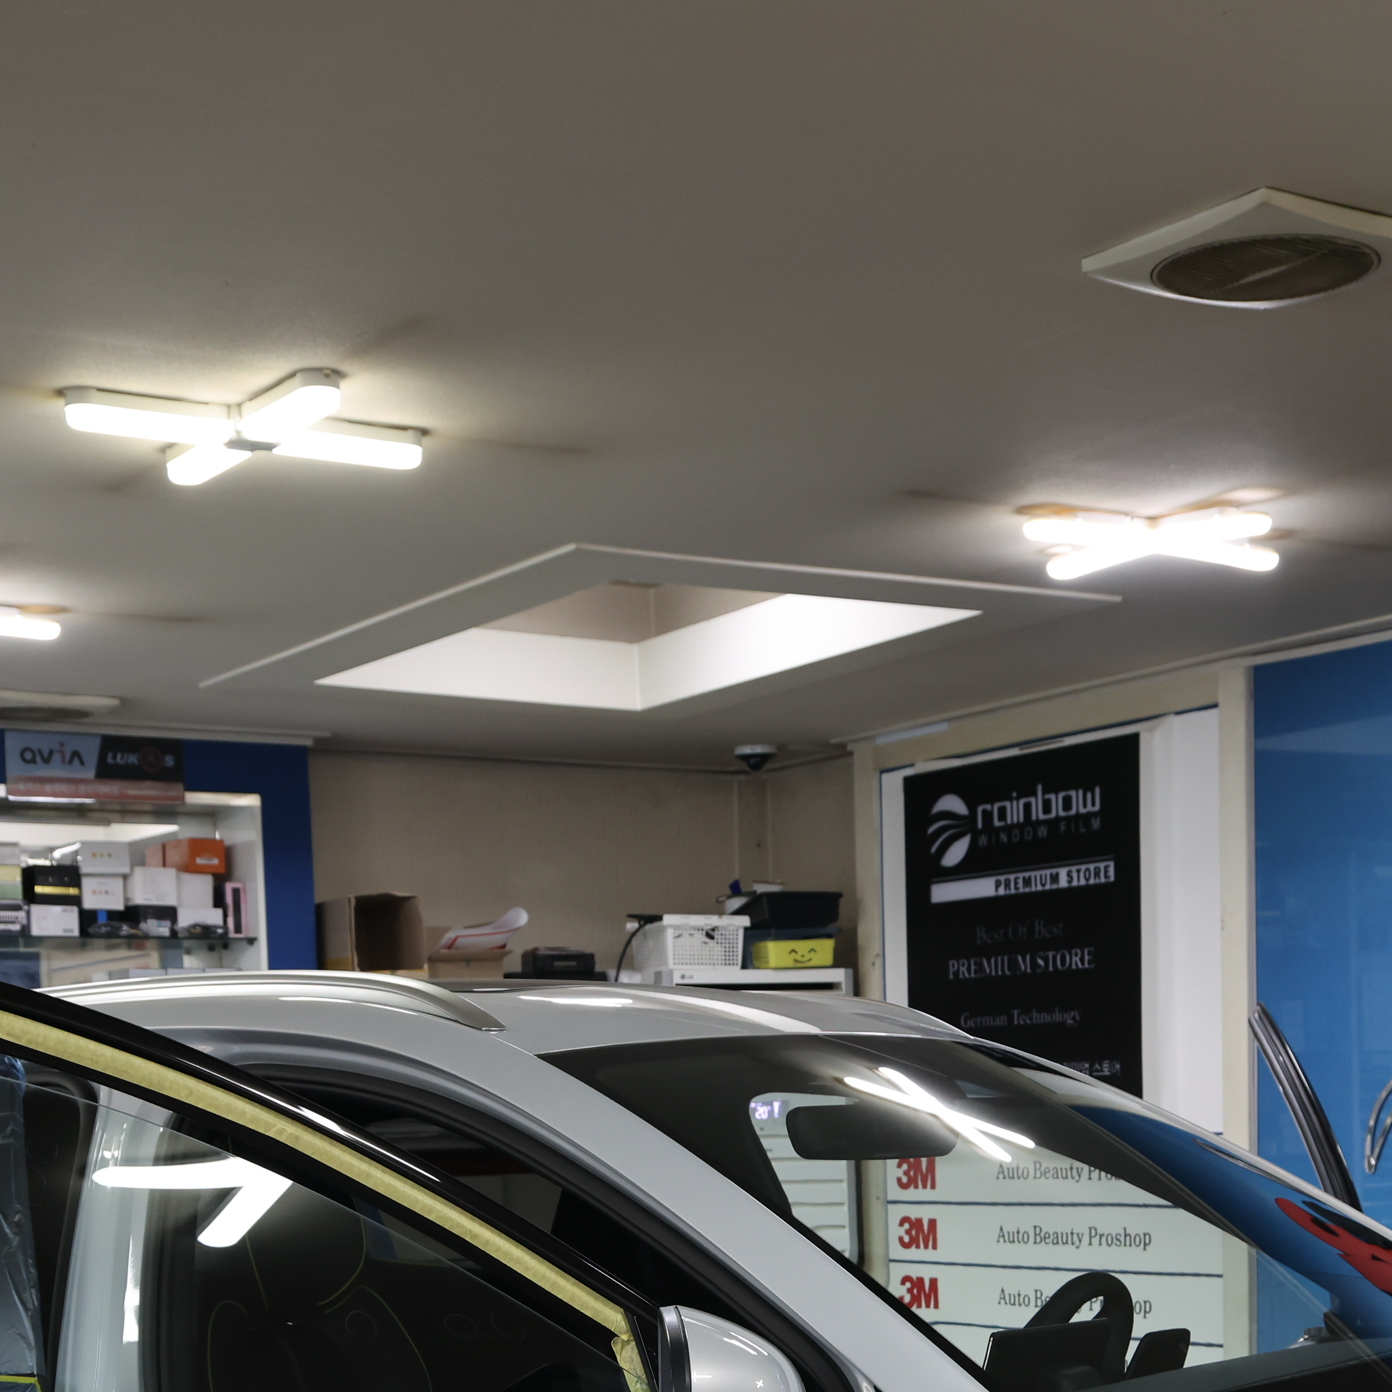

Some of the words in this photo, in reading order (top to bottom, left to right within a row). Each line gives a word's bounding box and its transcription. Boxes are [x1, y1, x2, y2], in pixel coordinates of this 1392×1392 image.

[977, 783, 1101, 829] rainbow
[977, 825, 1048, 847] WINDOW
[1060, 816, 1101, 834] FILM
[994, 871, 1060, 894] PREMIUM
[1066, 864, 1111, 885] STORE
[976, 925, 1005, 945] Best
[1034, 919, 1064, 938] Best
[949, 953, 1031, 979] PREMIUM
[1036, 947, 1095, 973] STORE
[960, 1012, 1008, 1028] German
[1012, 1007, 1081, 1027] Technology
[1092, 1060, 1122, 1077] 스토어
[896, 1157, 936, 1190] 3M
[996, 1161, 1029, 1180] Auto
[1033, 1160, 1084, 1183] Beauty
[898, 1215, 938, 1250] 3M
[996, 1225, 1030, 1244] Auto
[1033, 1225, 1084, 1249] Beauty
[1087, 1226, 1152, 1251] Proshop
[898, 1275, 939, 1309] 3M
[998, 1287, 1030, 1308] Auto
